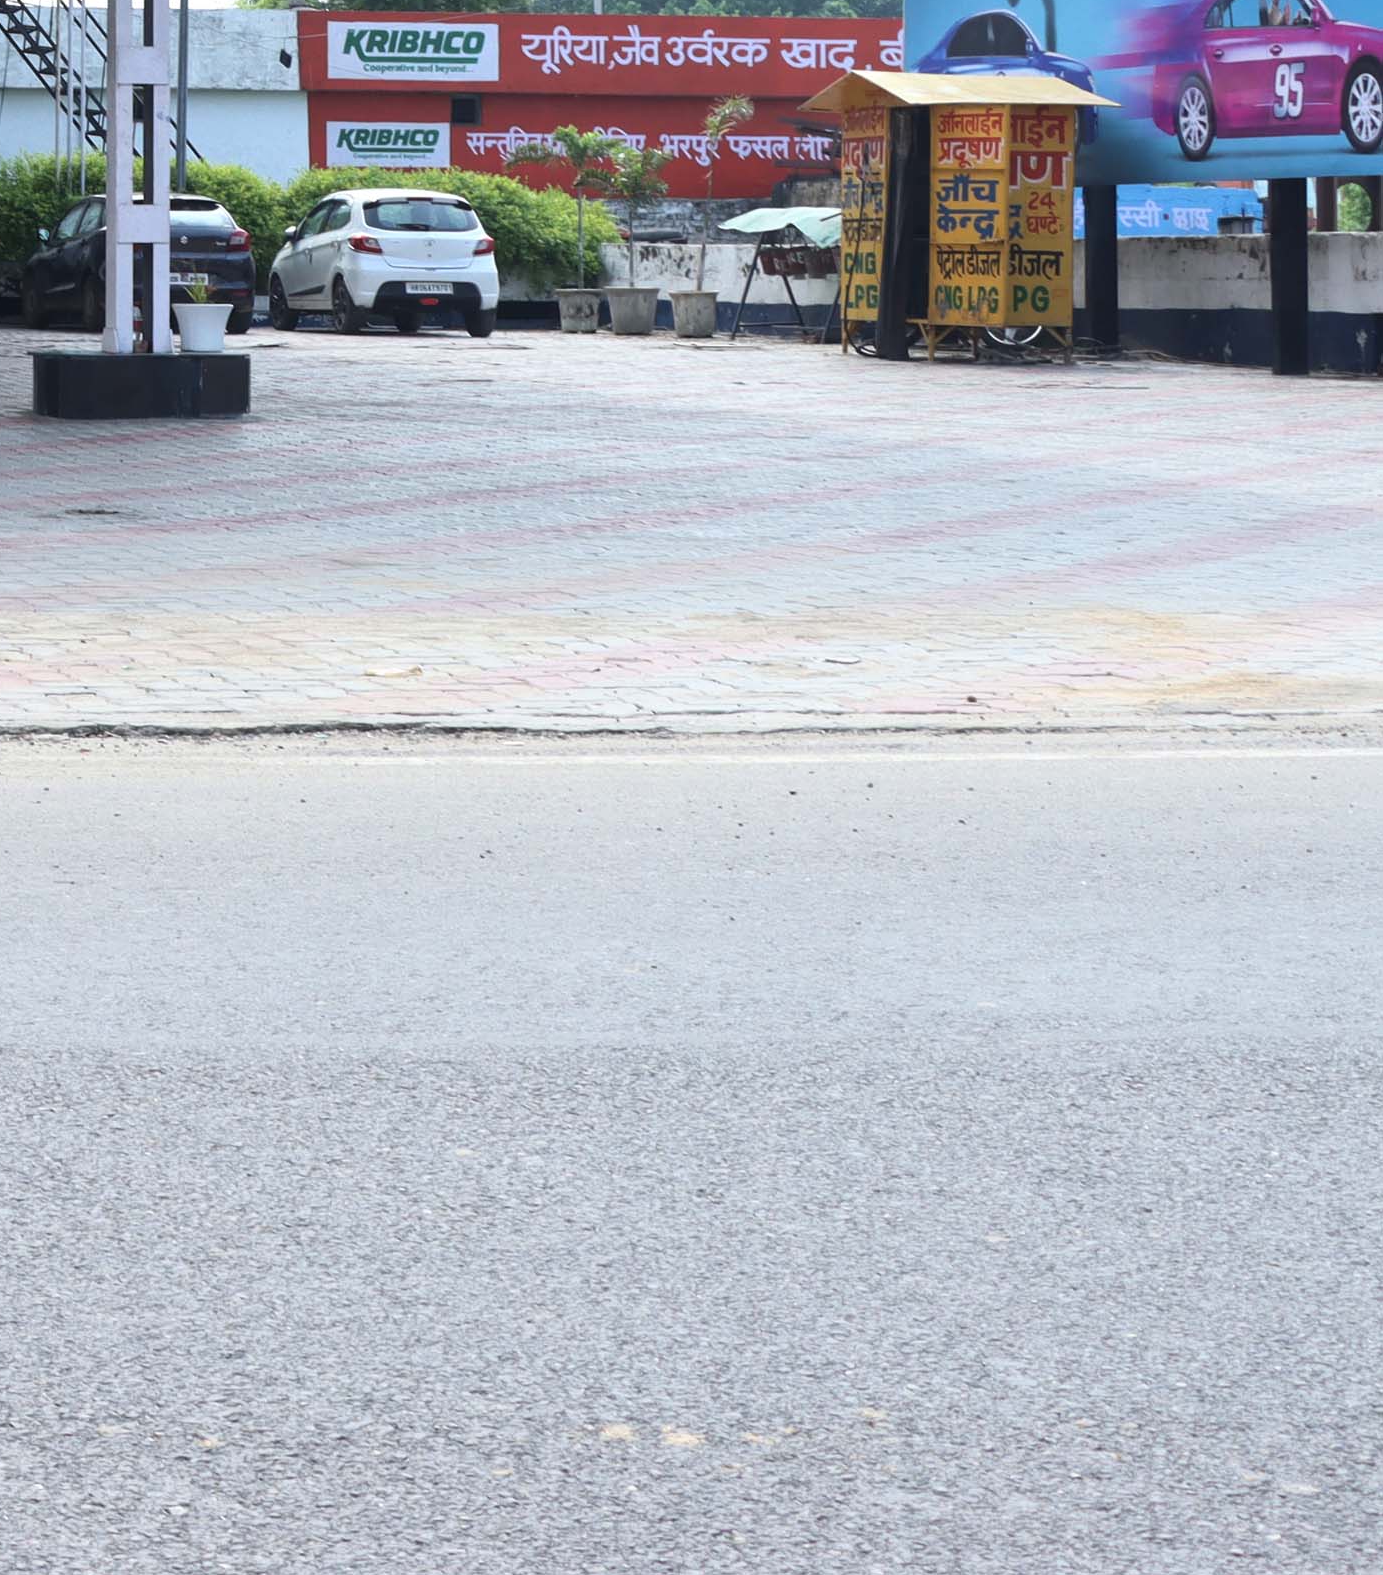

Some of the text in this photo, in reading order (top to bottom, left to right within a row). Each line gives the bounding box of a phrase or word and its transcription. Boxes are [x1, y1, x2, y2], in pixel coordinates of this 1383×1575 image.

[342, 28, 486, 56] KRIBHCO
[665, 29, 770, 68] उर्वरक
[780, 37, 858, 72] खाद
[363, 63, 415, 74] Cooperative
[417, 64, 433, 73] and
[1273, 61, 1306, 119] 95
[336, 128, 440, 148] KRIBHCO
[725, 134, 791, 160] फसल
[938, 136, 1003, 167] प्रदूषण
[843, 252, 877, 275] CNG
[965, 245, 1002, 279] डीजल
[845, 284, 879, 309] LPG
[935, 285, 999, 313] CNG LPG
[1013, 285, 1050, 313] PG
